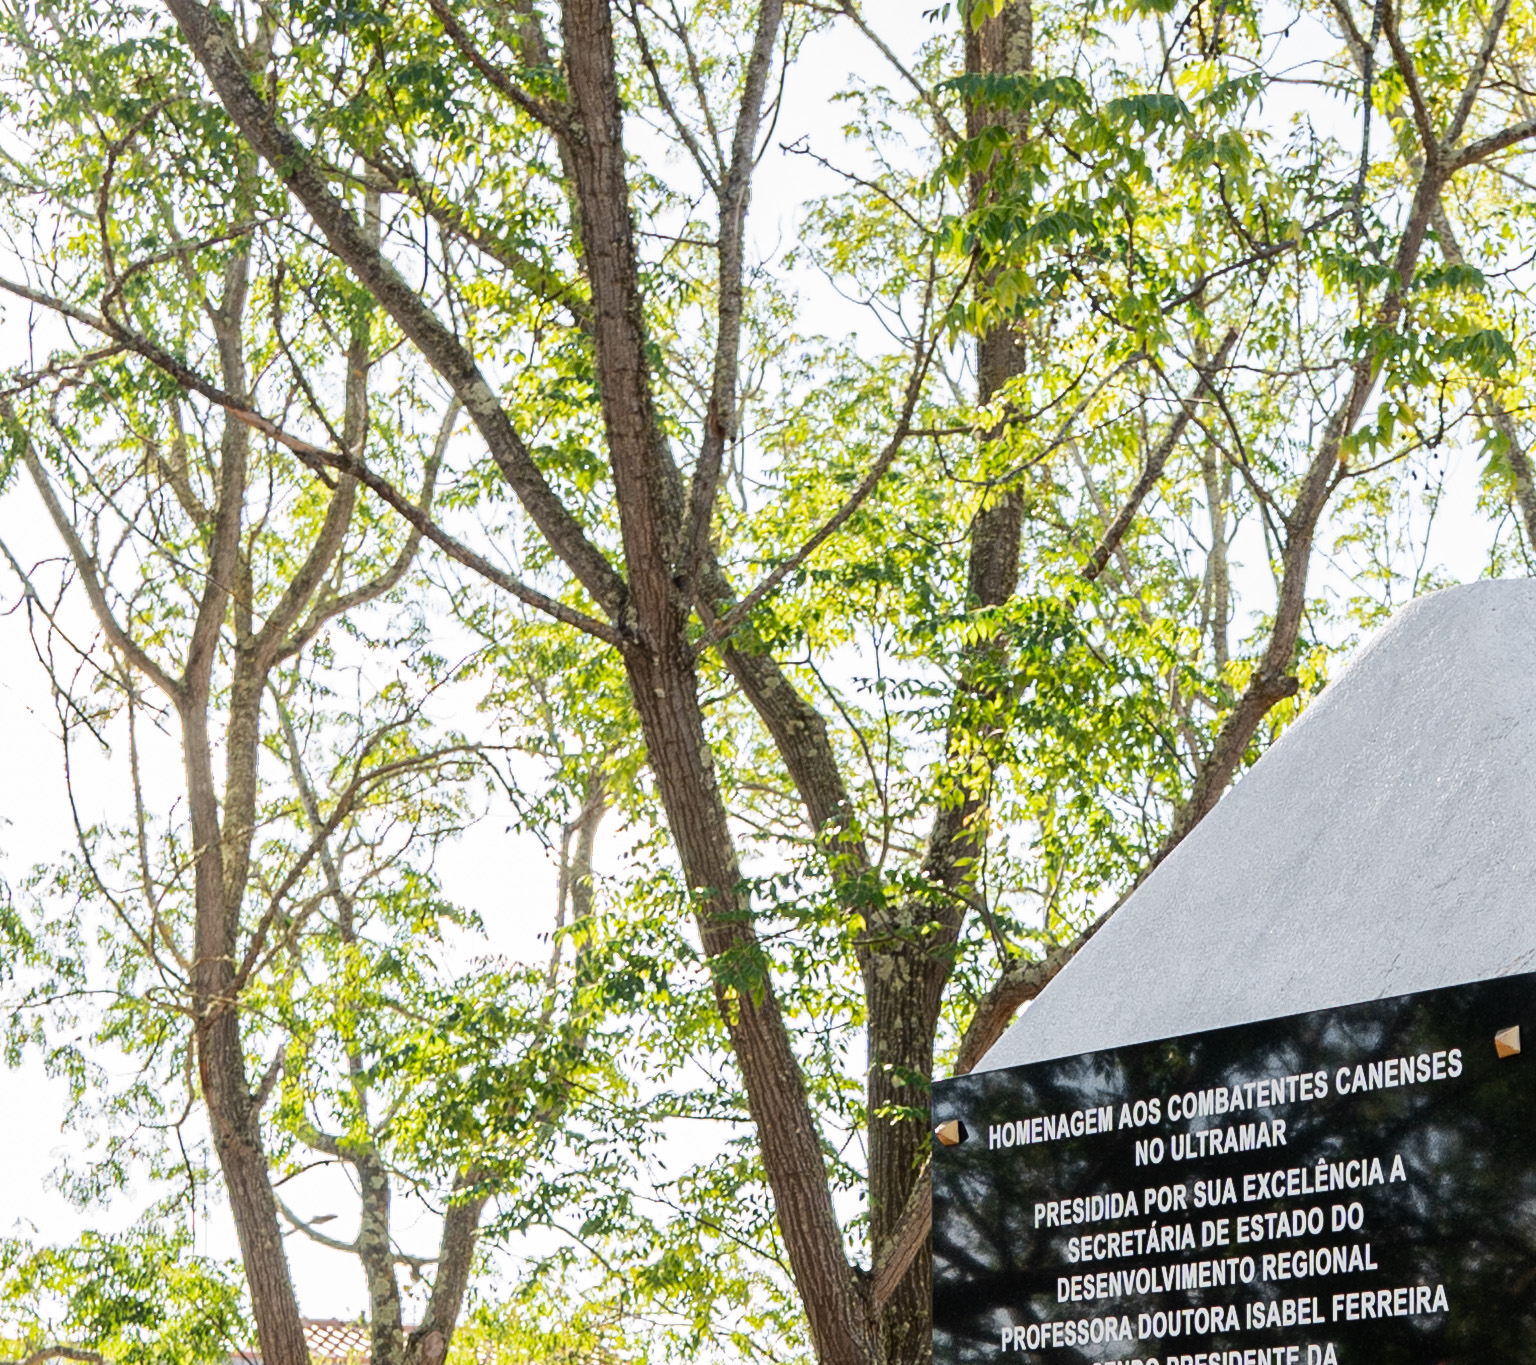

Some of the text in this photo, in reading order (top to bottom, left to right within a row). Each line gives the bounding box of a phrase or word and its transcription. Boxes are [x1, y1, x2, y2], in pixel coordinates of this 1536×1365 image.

[990, 1049, 1462, 1149] HOMENAGEM AOS COMBATENTES CANENSES
[1136, 1119, 1286, 1166] NO ULTRAMAR
[1035, 1155, 1406, 1228] PRESIDIDA POR SUA EXCELÊNCIA A
[1067, 1202, 1363, 1262] SECRETÁRIA DE ESTADO DO
[1058, 1244, 1377, 1302] DESENVOLVIMENTO REGIONAL
[1001, 1285, 1449, 1352] PROFESSORA DOUTORA ISABEL FERREIRA
